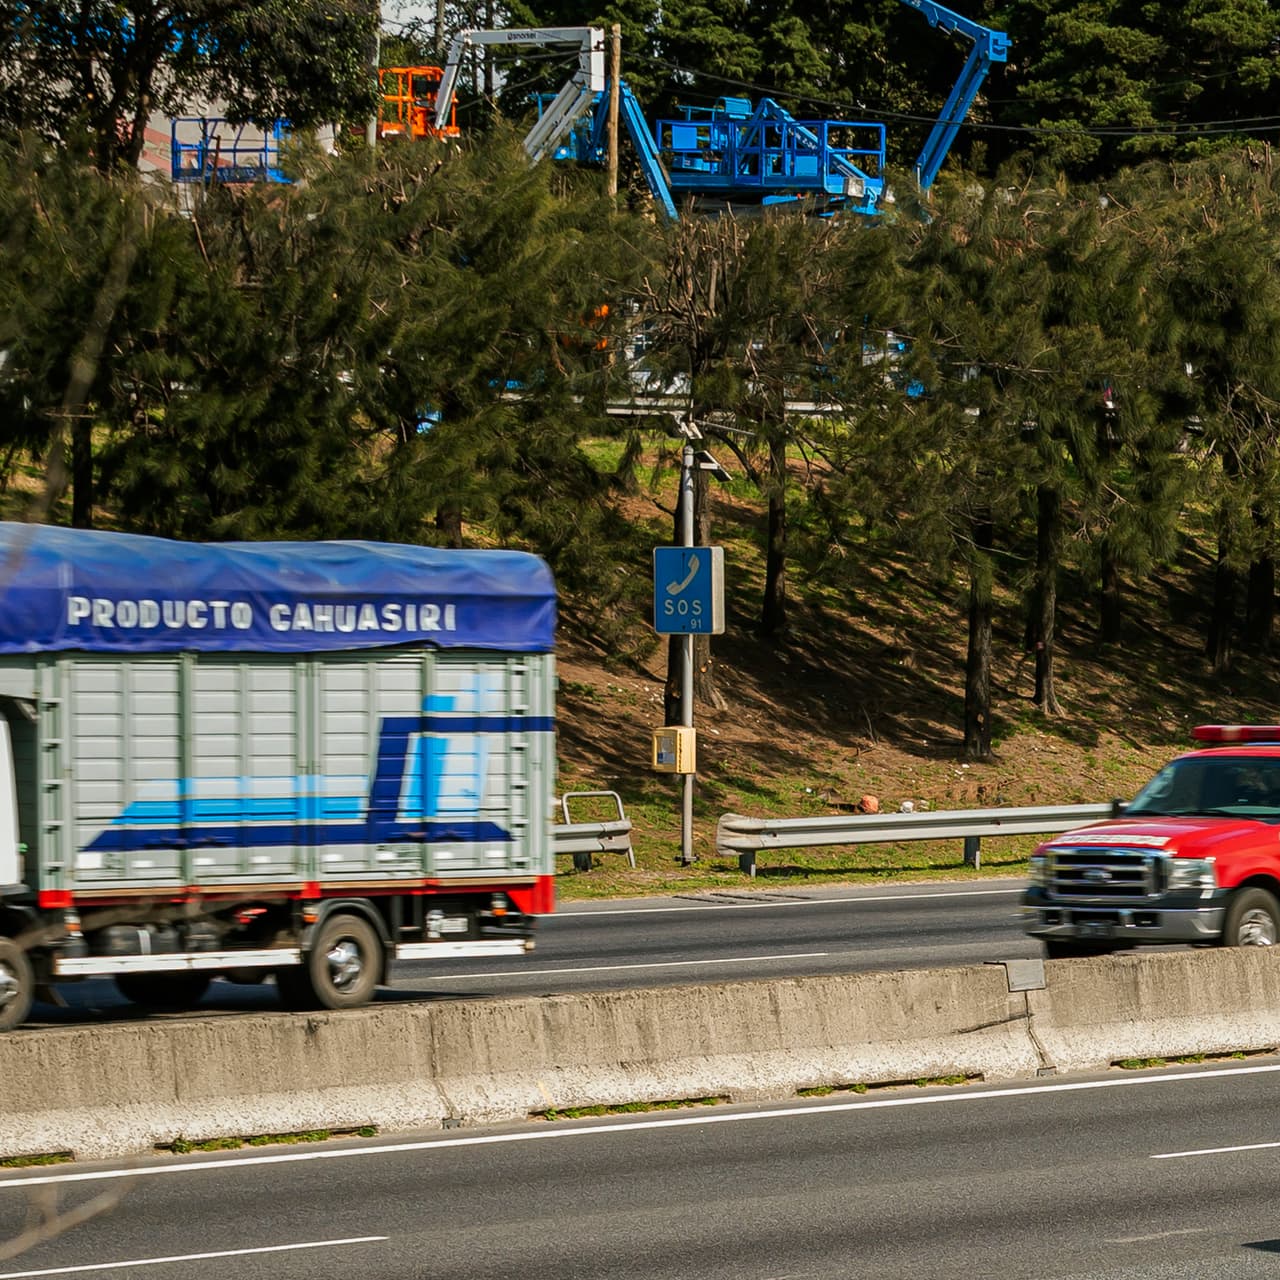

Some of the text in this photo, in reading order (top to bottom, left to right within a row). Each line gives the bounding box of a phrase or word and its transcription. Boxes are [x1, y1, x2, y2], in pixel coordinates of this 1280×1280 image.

[67, 596, 457, 633] PRODUCTO CAHUASIRI
[664, 599, 702, 616] SOS
[690, 618, 702, 630] 91
